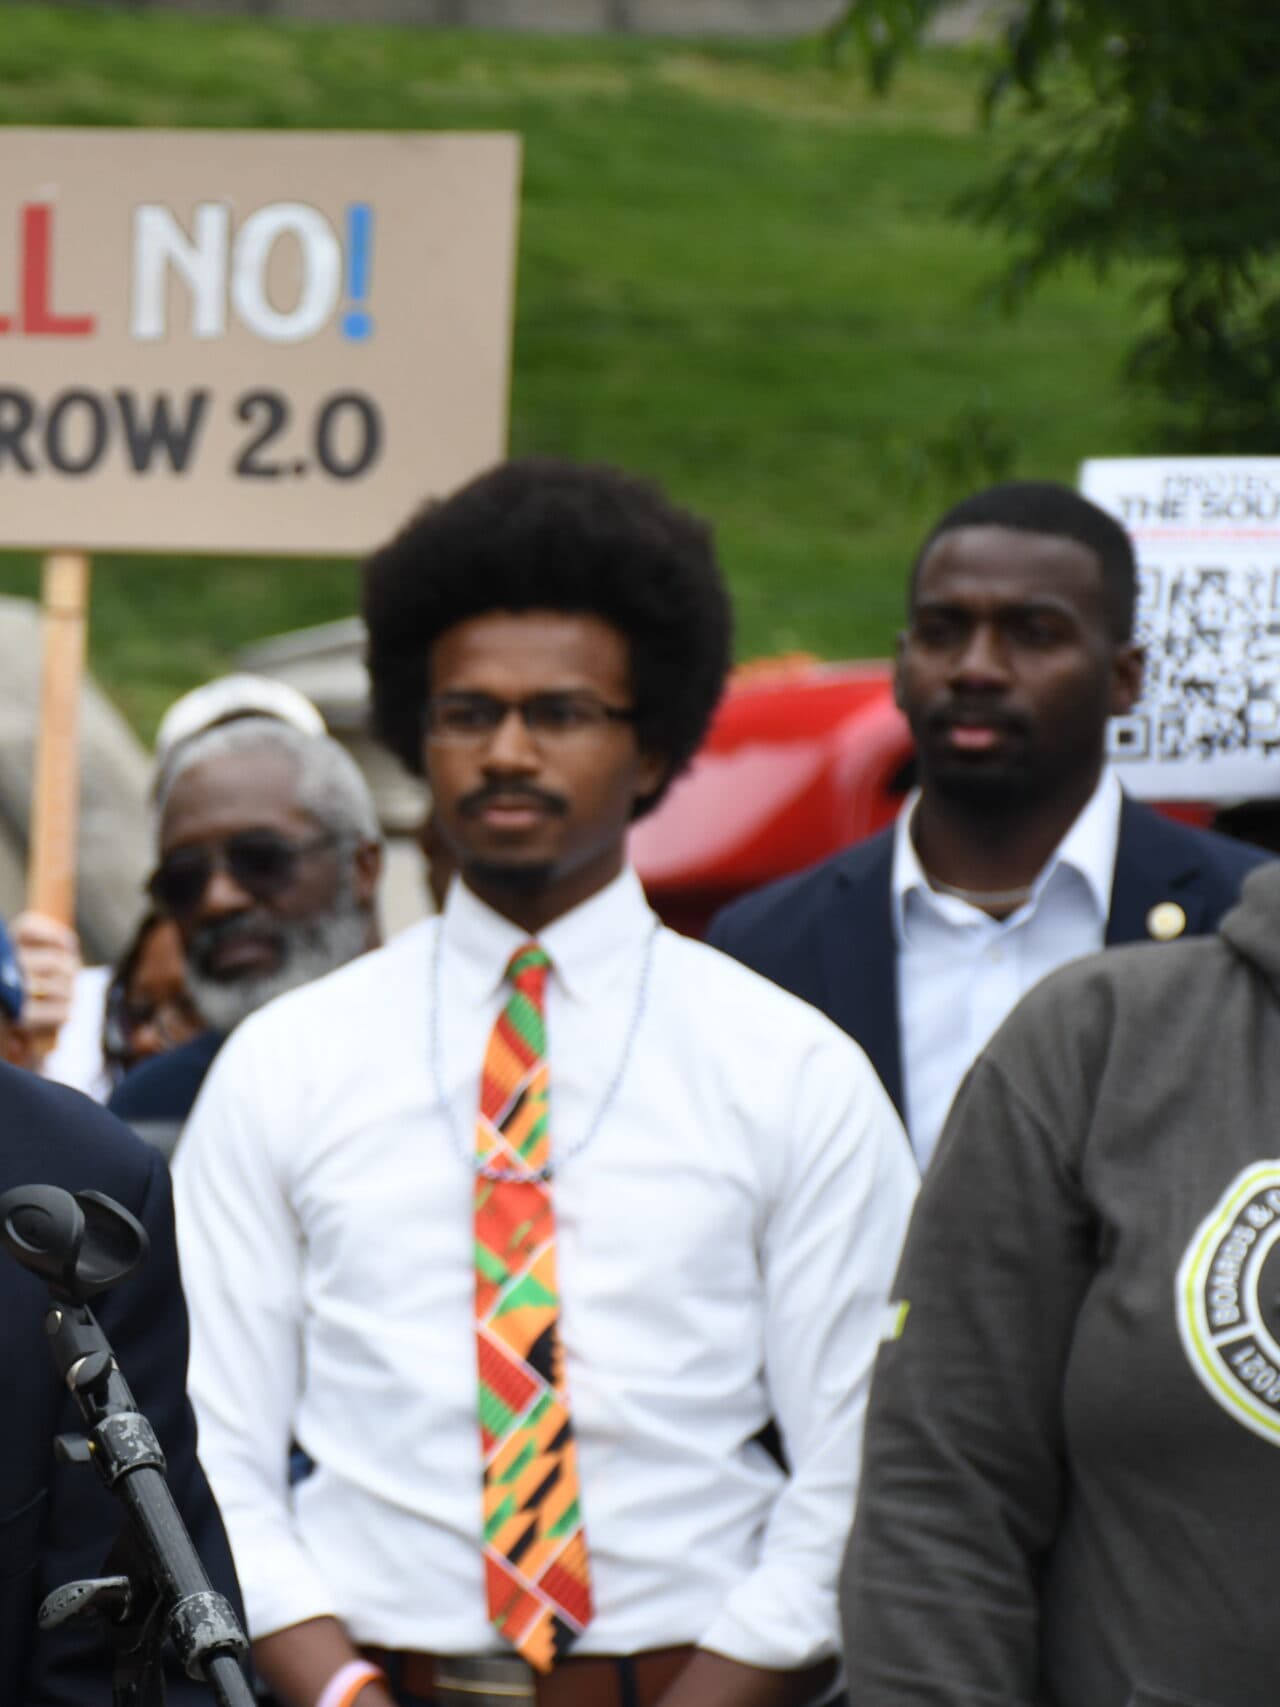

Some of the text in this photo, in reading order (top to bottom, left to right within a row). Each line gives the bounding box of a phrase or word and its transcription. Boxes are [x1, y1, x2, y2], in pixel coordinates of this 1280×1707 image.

[130, 200, 375, 343] NO!
[231, 387, 384, 482] 2.0
[1118, 494, 1187, 521] THE
